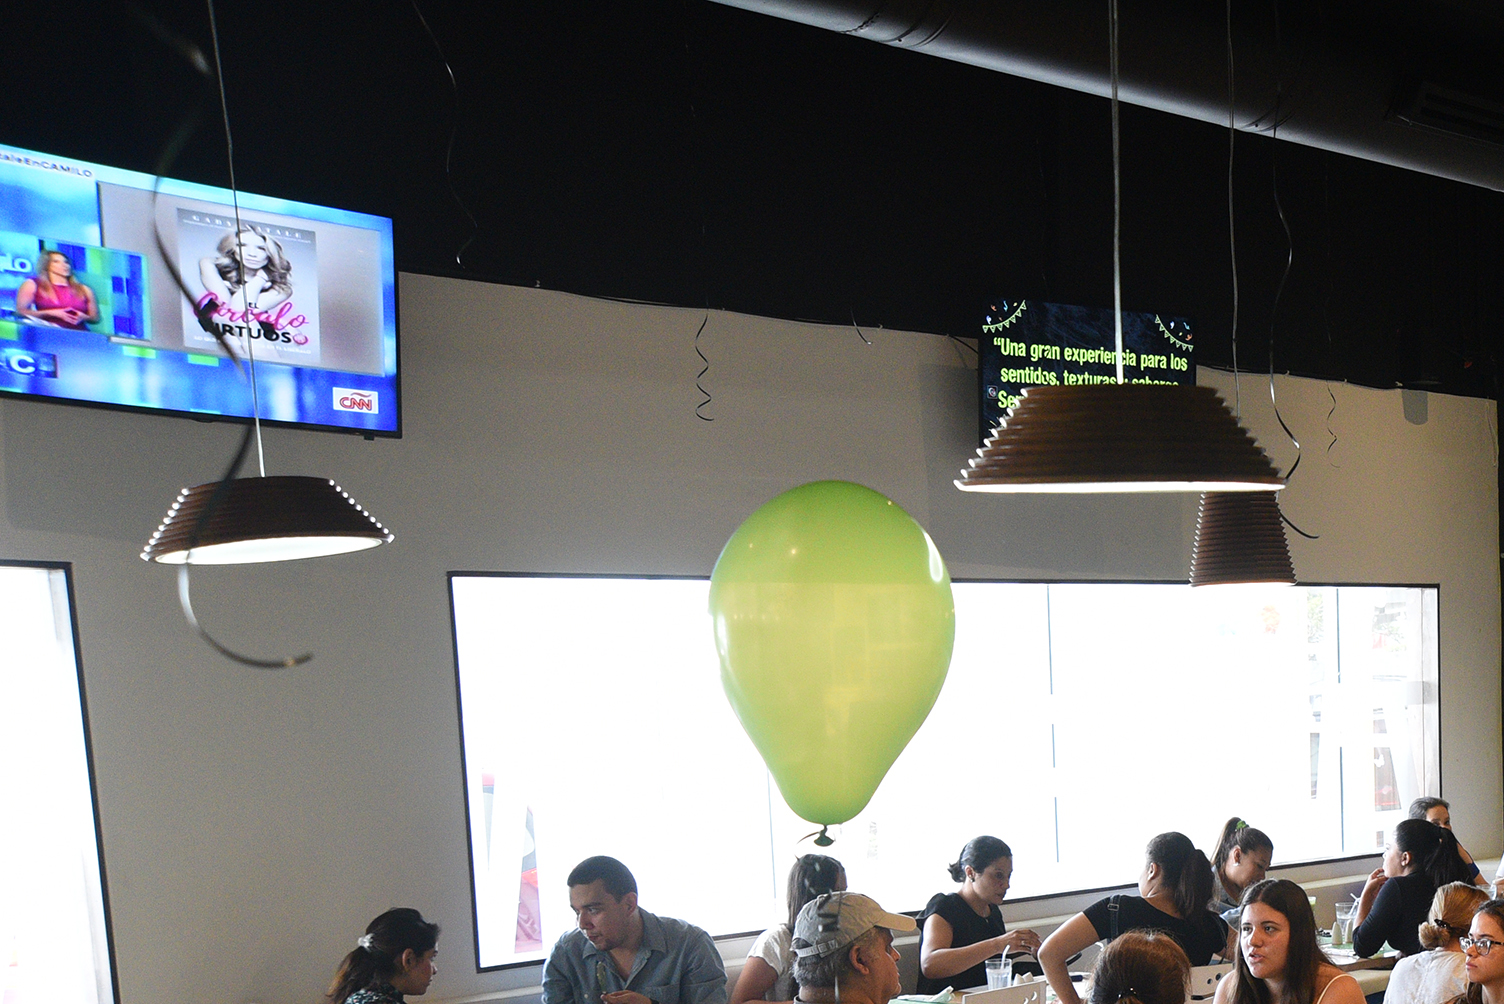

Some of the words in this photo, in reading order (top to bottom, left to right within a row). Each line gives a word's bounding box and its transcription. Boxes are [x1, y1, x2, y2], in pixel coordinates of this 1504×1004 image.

[1030, 343, 1061, 362] gran
[1063, 346, 1137, 366] experiencia
[1140, 354, 1167, 371] para
[1170, 353, 1188, 372] los
[339, 392, 373, 411] CNN
